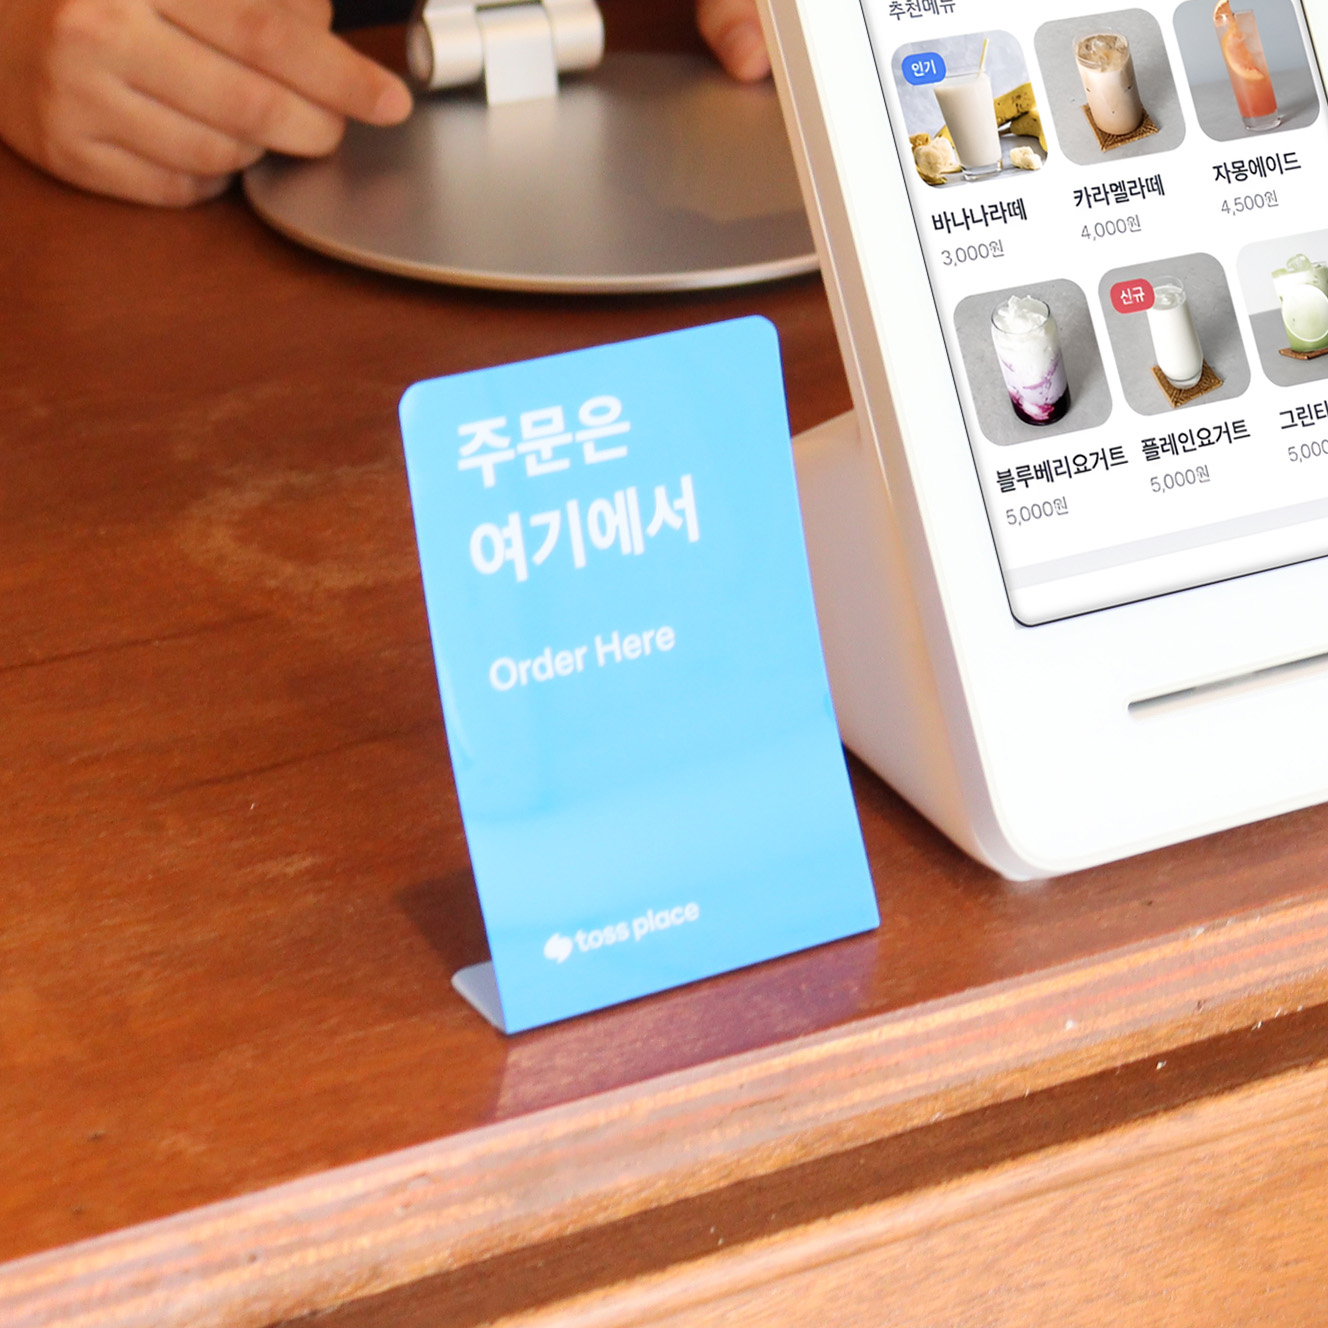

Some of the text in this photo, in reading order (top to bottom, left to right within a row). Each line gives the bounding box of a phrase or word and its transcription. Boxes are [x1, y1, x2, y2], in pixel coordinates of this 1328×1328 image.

[910, 57, 937, 79] 인기
[1212, 150, 1302, 186] 자몽에이드
[1072, 173, 1166, 210] 카라멜라떼
[1220, 188, 1279, 217] 4,500원
[931, 197, 1028, 234] 바나나라떼
[1080, 213, 1142, 242] 4,000원
[940, 238, 1005, 268] 3,000원
[1119, 285, 1147, 306] 신규
[456, 394, 631, 489] 주문은
[1140, 418, 1252, 464] 플레인요거트
[995, 444, 1130, 494] 블루베리요거트
[1149, 464, 1212, 495] 5,000원
[468, 473, 702, 583] 여기에서
[1005, 495, 1070, 527] 5,000원
[488, 625, 676, 693] Order Here
[574, 901, 701, 954] toss place
